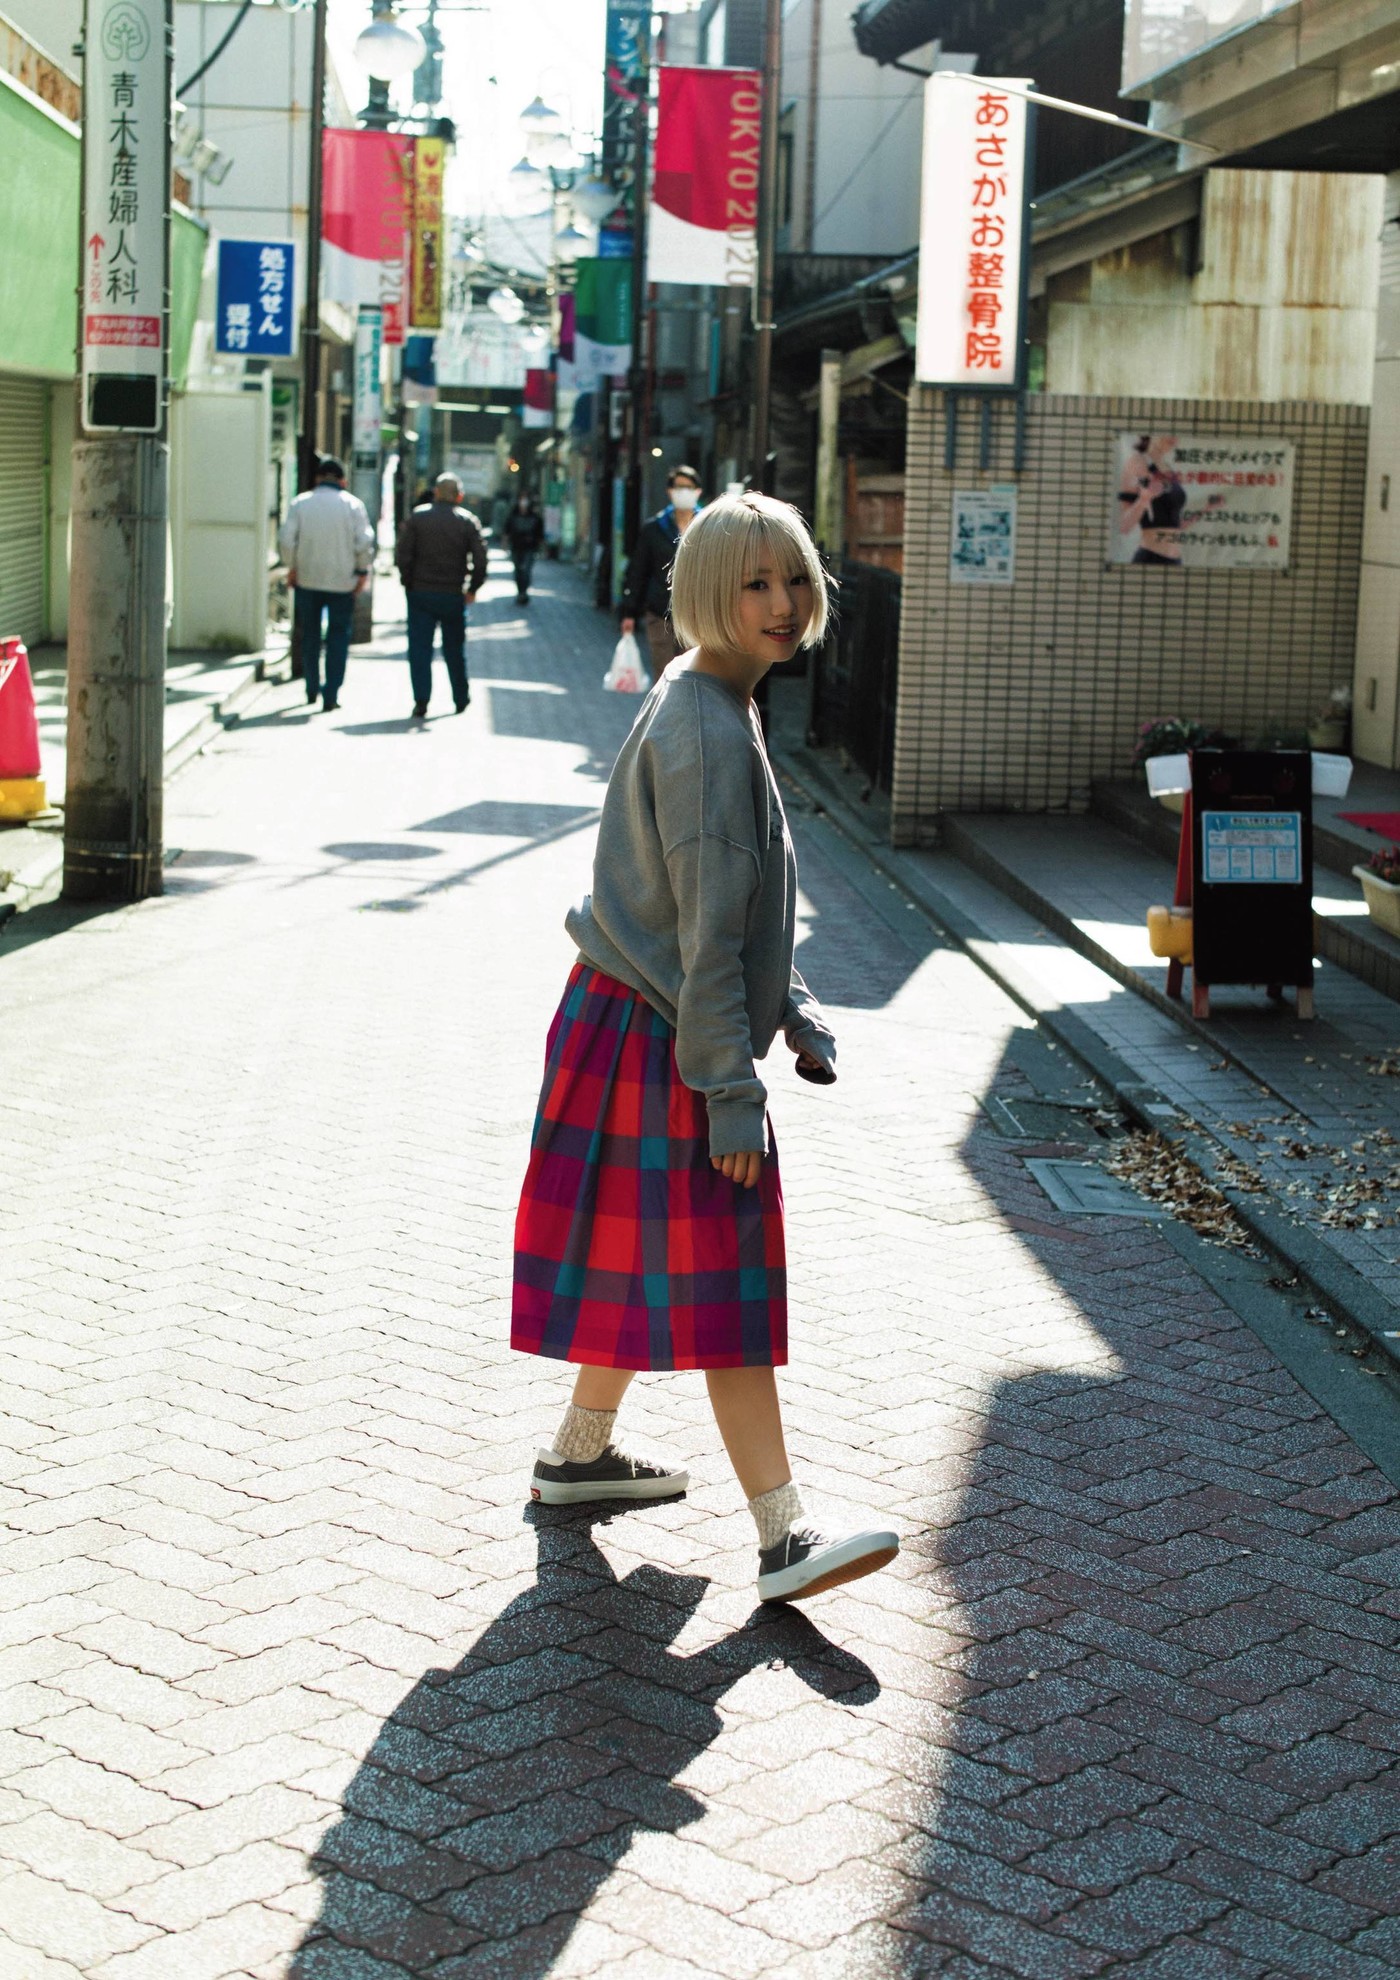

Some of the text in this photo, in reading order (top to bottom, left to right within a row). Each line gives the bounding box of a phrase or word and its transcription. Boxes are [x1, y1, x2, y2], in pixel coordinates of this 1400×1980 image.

[107, 71, 140, 304] 青木産婦人科
[965, 91, 1010, 369] あさがお整骨院
[726, 199, 758, 288] 2020
[226, 303, 251, 349] 受付
[259, 247, 287, 336] 処方せん
